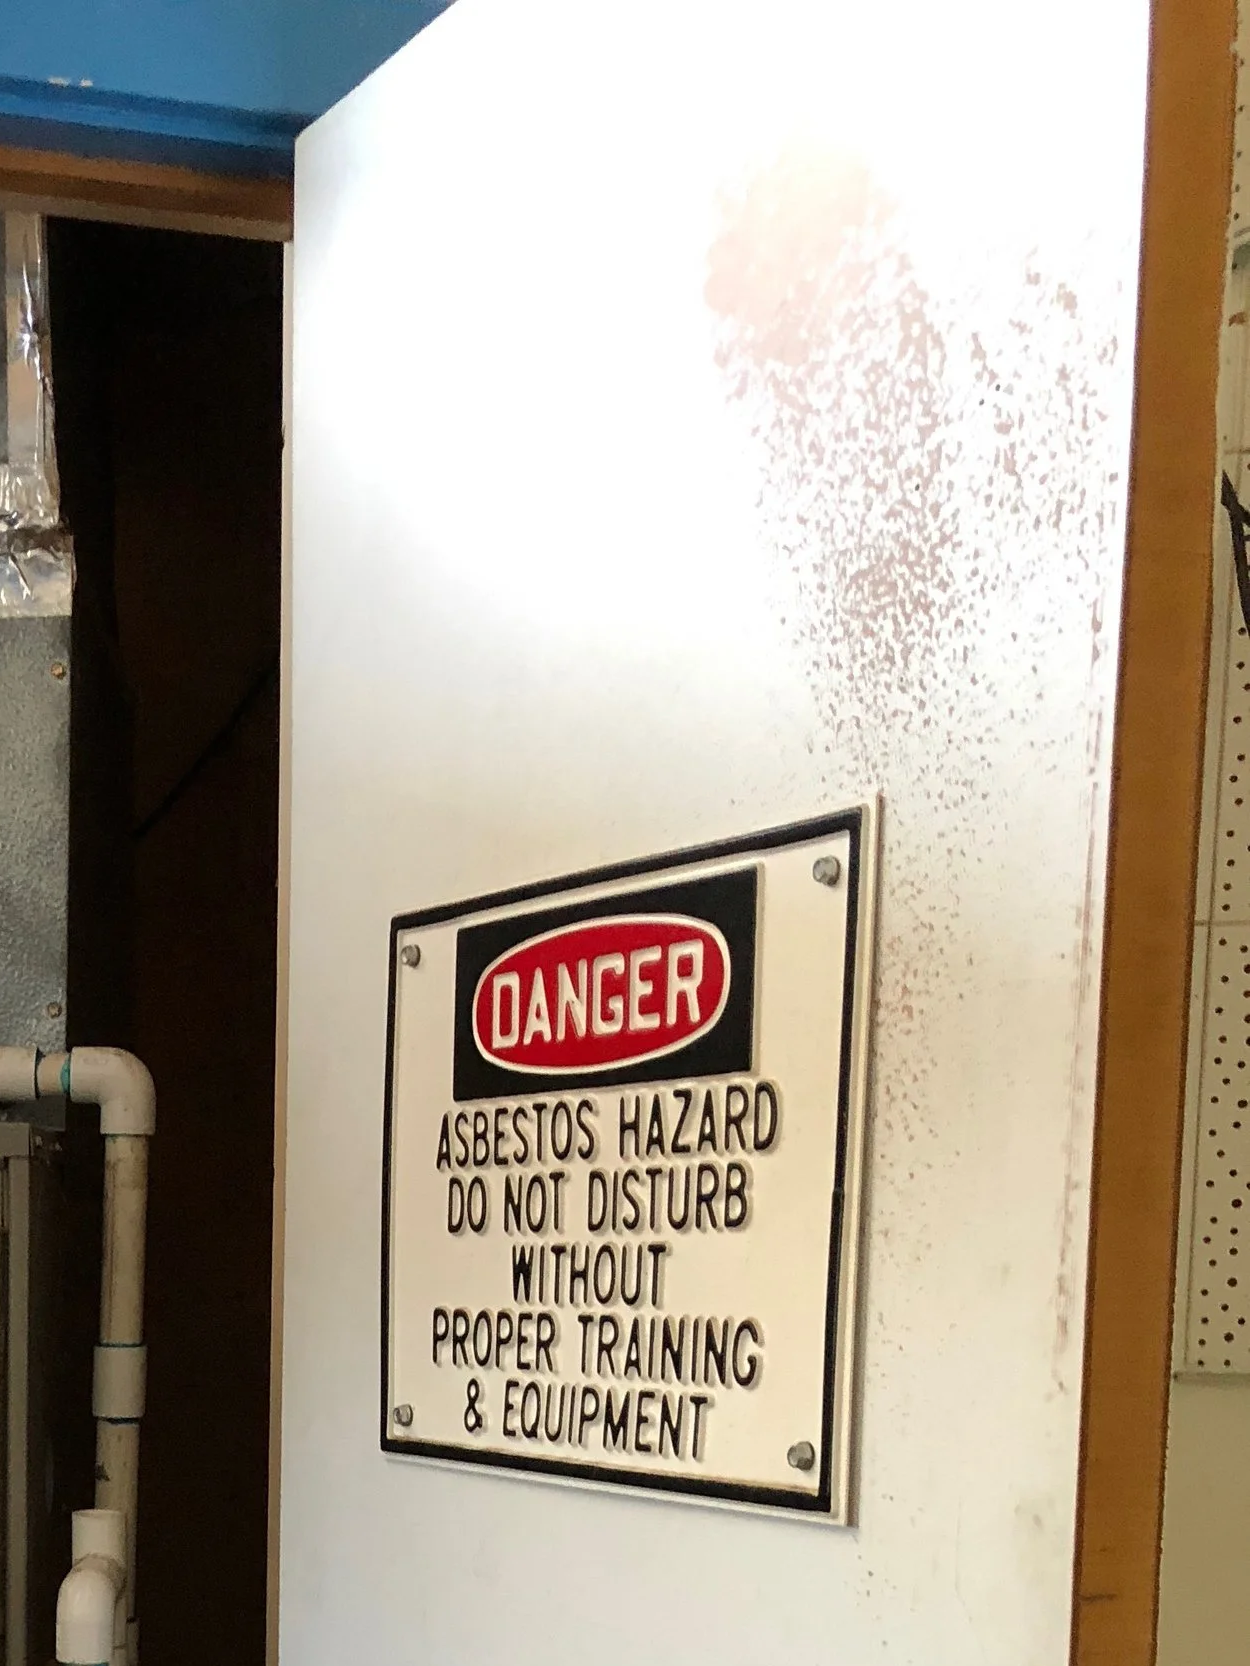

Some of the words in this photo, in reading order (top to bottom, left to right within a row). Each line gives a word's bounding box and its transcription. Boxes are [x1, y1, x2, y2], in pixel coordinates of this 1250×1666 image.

[491, 939, 704, 1050] DANGER
[436, 1099, 595, 1170] ASBESTOS
[619, 1082, 778, 1158] HAZARD
[447, 1175, 487, 1234] DO
[503, 1171, 566, 1234] NOT
[587, 1162, 748, 1232] DISTURB
[512, 1243, 667, 1307] WITHOUT
[432, 1307, 556, 1372] PROPER
[577, 1314, 759, 1387] TRAINING
[463, 1378, 483, 1433] &
[502, 1379, 708, 1459] EQUIPMENT
